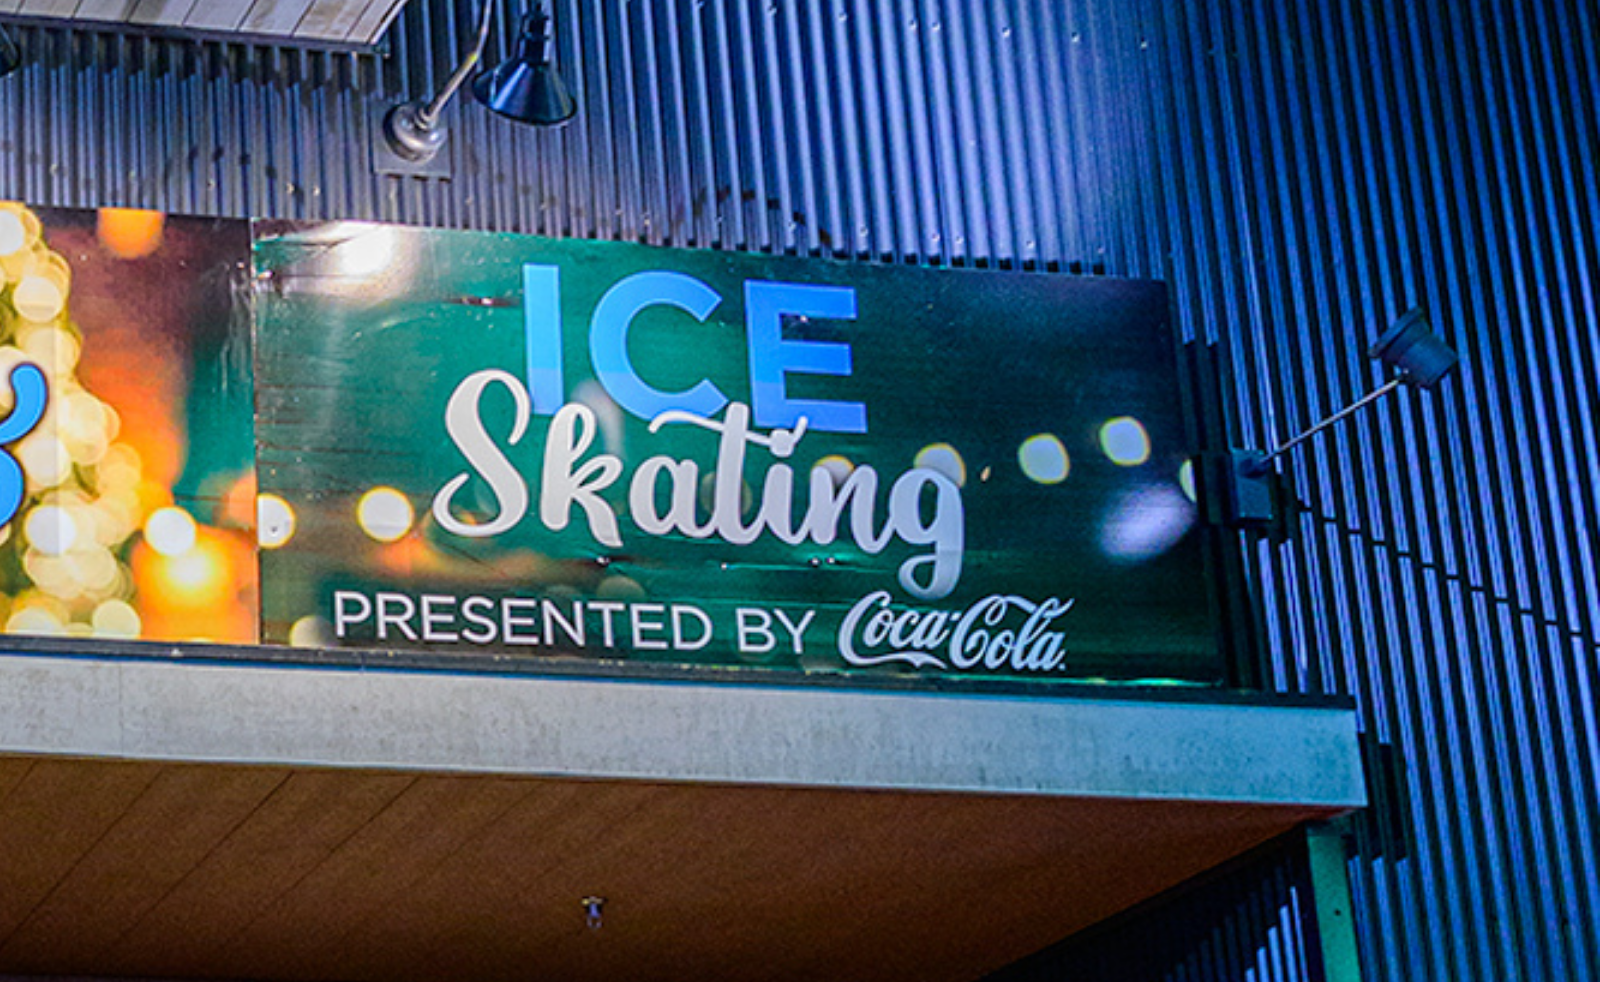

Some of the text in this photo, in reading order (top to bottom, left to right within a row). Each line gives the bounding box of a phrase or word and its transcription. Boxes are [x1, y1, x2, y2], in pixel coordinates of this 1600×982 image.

[521, 262, 868, 434] ICE
[432, 369, 966, 598] Skating
[333, 590, 713, 653] PRESENTED
[737, 607, 816, 655] BY
